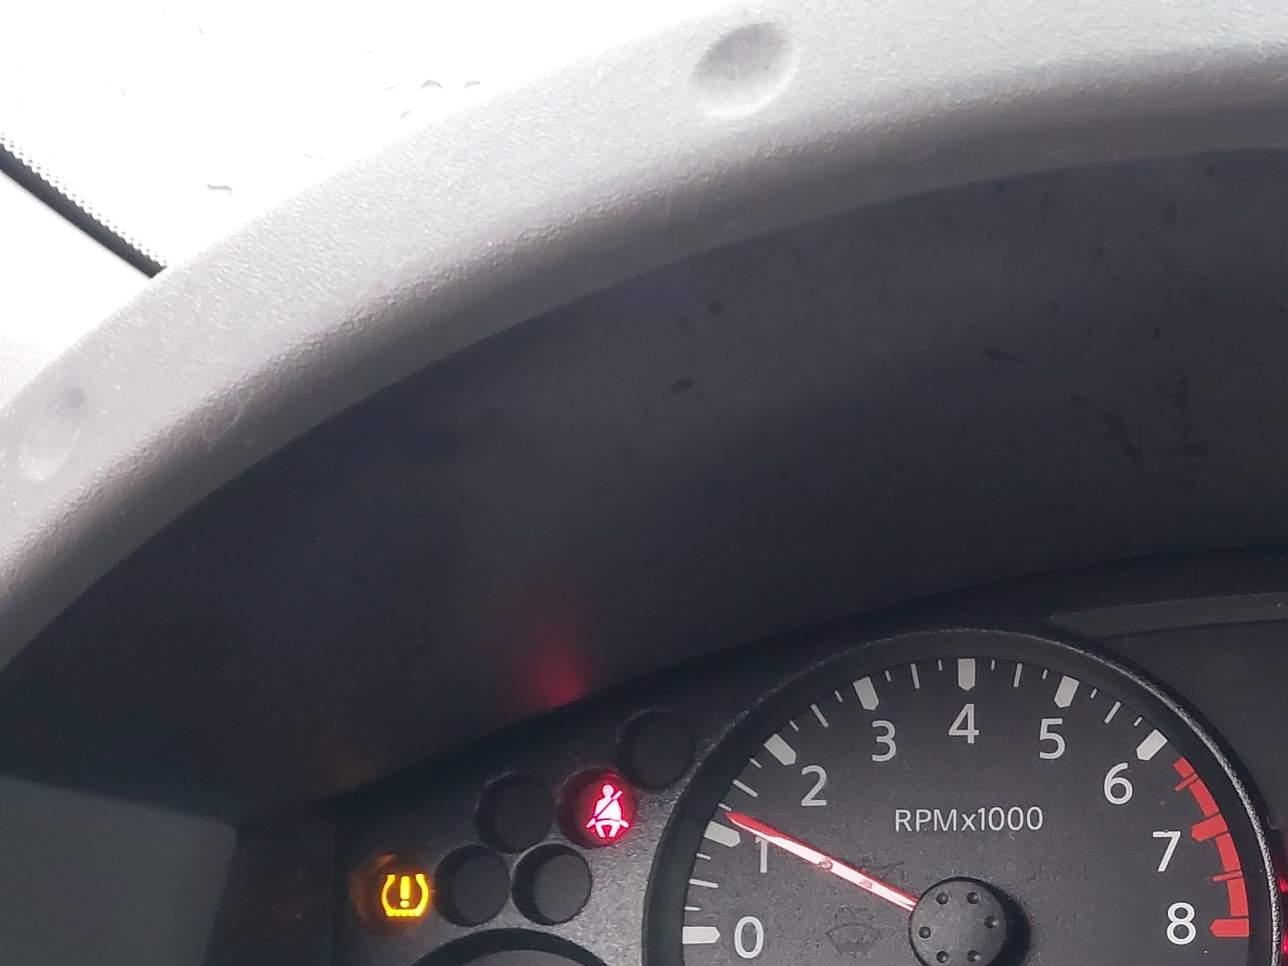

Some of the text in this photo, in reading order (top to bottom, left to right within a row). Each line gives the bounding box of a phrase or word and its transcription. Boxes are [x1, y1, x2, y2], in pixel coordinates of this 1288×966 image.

[872, 720, 896, 761] 3
[949, 704, 979, 743] 4
[1040, 719, 1065, 759] 5
[801, 765, 827, 806] 2
[1104, 763, 1132, 804] 6
[896, 807, 1042, 831] RPMx1000
[755, 836, 768, 873] 1
[1153, 831, 1180, 871] 7
[735, 917, 763, 958] 0
[1167, 903, 1196, 944] 8
